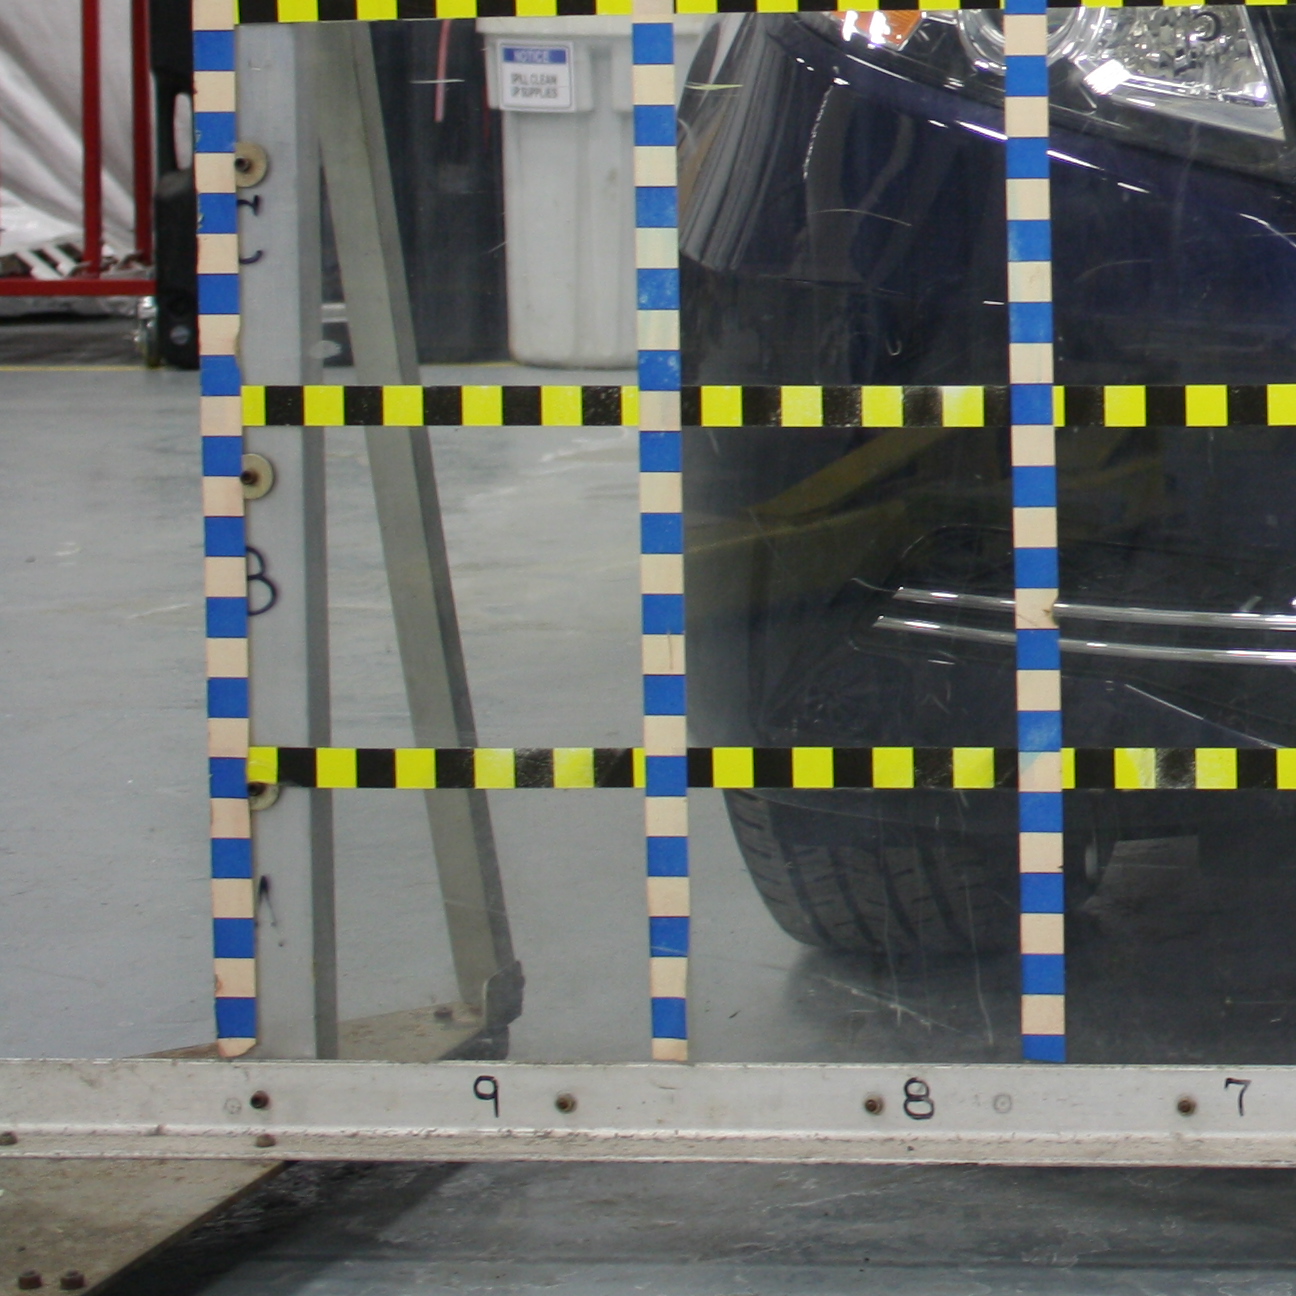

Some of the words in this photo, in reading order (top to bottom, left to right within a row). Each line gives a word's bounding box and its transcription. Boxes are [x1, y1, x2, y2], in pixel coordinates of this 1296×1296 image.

[513, 49, 549, 64] NOTICE
[473, 1075, 500, 1119] 9
[903, 1077, 935, 1121] 8
[1224, 1077, 1251, 1117] 7
